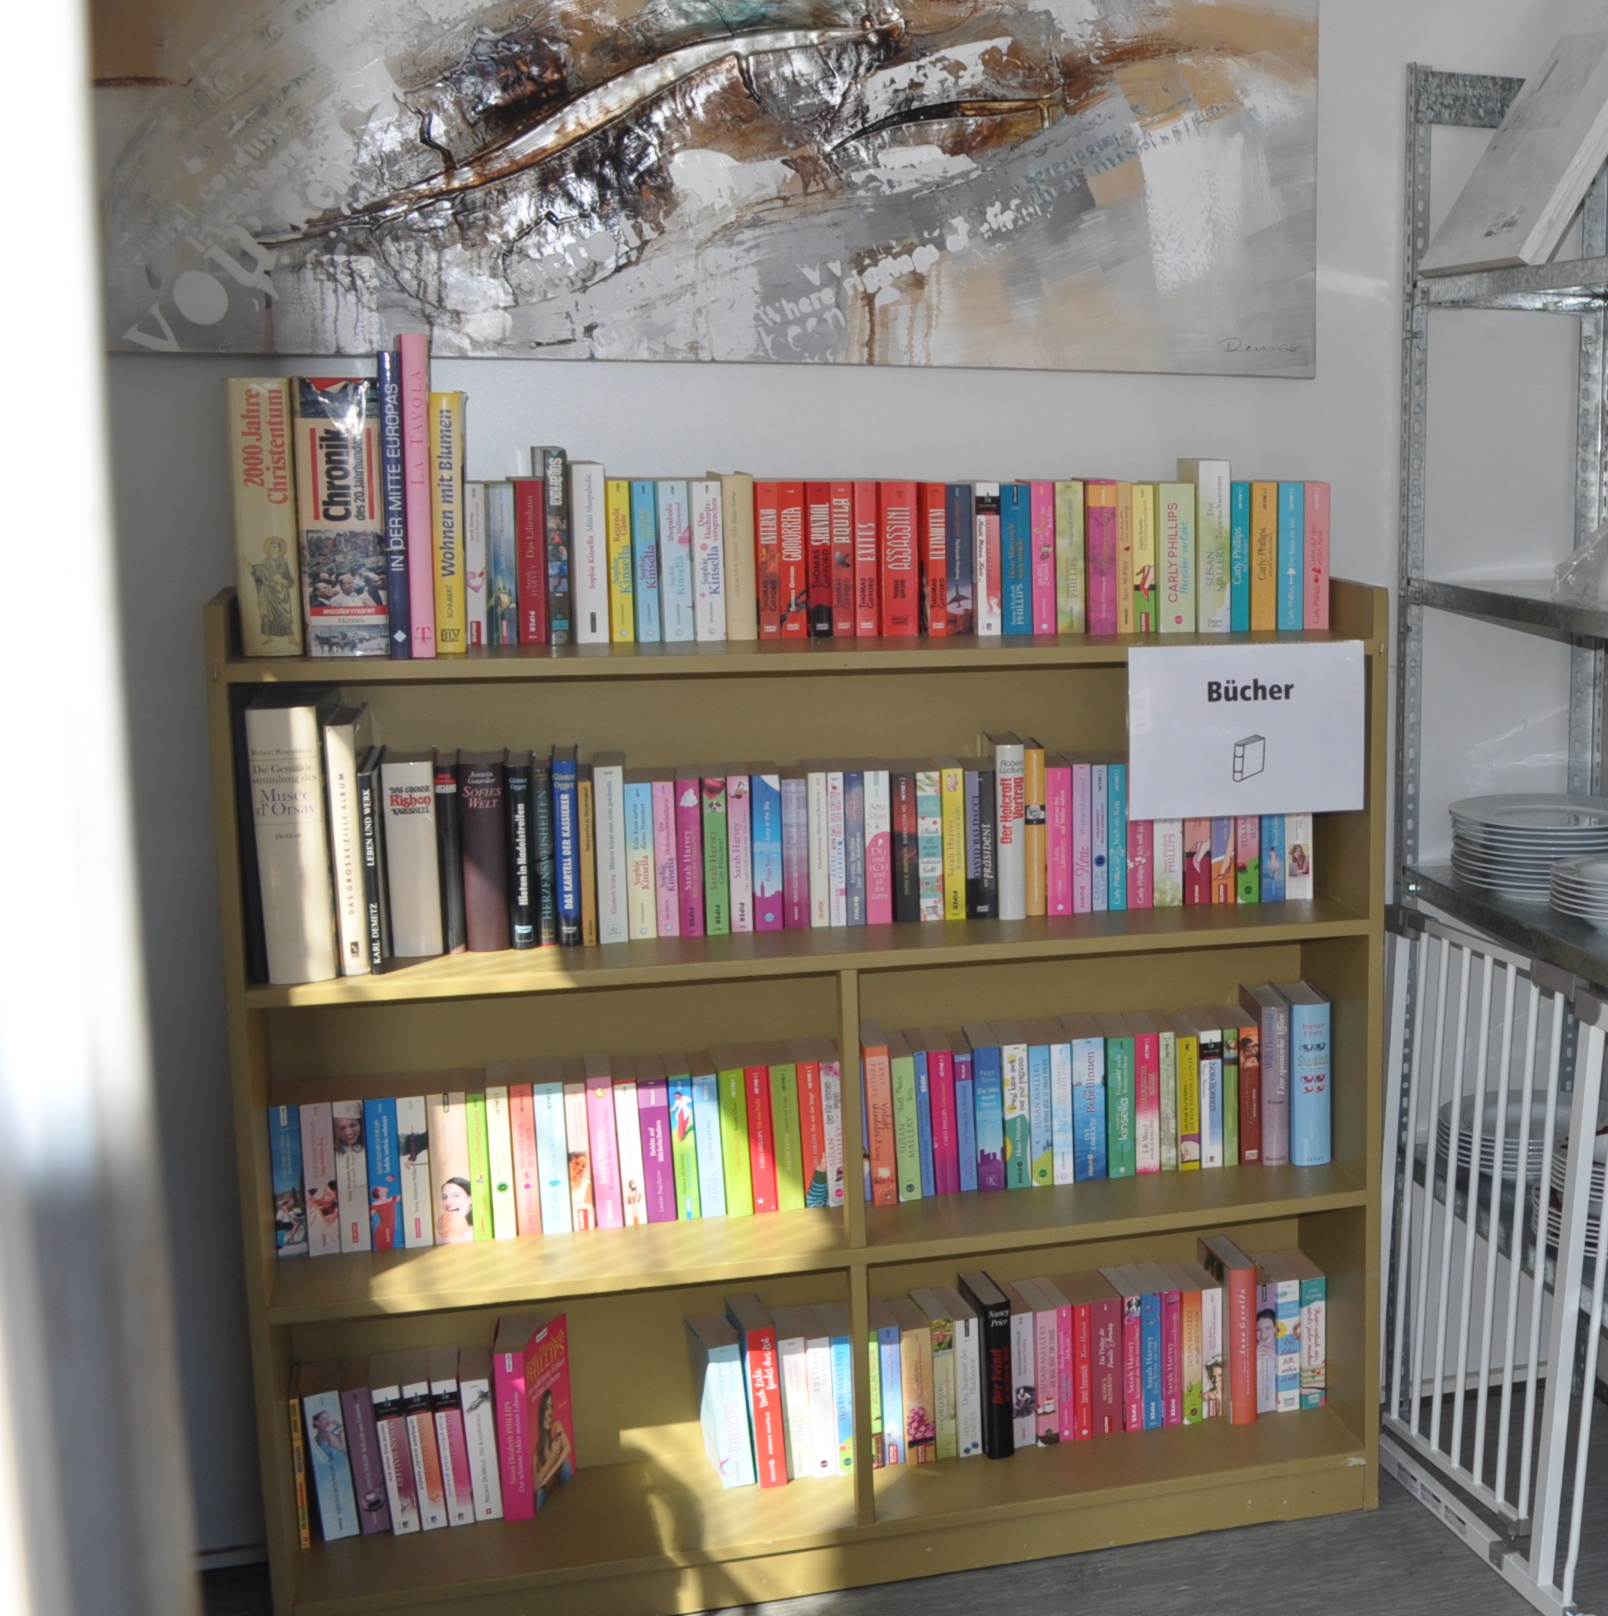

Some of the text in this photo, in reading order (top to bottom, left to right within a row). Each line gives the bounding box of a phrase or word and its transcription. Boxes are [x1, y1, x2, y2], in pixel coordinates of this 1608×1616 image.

[240, 388, 265, 488] 2000 Jahre
[265, 388, 288, 505] Christentum
[409, 371, 425, 485] LA TAVOLA
[319, 429, 352, 522] Chronik
[353, 435, 365, 521] des 20.Jahrhunder
[385, 383, 405, 571] IN DER MITTE EUROPAS
[439, 409, 458, 578] Wohnen mit Blumen
[760, 508, 777, 544] INFERNO
[782, 506, 802, 561] GOMORRHA
[810, 502, 830, 546] SKANDAL
[833, 498, 852, 544] AQUILA
[857, 522, 875, 561] EXITUS
[887, 506, 911, 570] ASSASSINI
[929, 508, 946, 560] ULTIMATUM
[619, 545, 631, 595] Kinsella
[646, 544, 656, 589] Kinsella
[708, 546, 720, 595] Kinsella
[1167, 502, 1178, 603] CARLY PHILLIPS
[1205, 551, 1214, 586] SUSAN
[1216, 545, 1224, 592] MALLERY
[1232, 526, 1242, 585] Carly Phillips
[1257, 528, 1267, 581] Carly Phillips
[1207, 679, 1294, 702] Bücher
[253, 765, 267, 774] Die
[261, 788, 311, 802] Musée
[462, 786, 502, 798] SOFIES
[389, 793, 431, 808] Kishon
[468, 798, 499, 809] WELT
[1000, 778, 1013, 844] Der Holcroft
[1013, 776, 1024, 819] Vertrag
[338, 772, 356, 915] DAS GROSSE ZILLE-ALBUM
[362, 788, 375, 867] LEBEN UND WERK
[514, 802, 529, 907] Nieten in Nadelstreifen
[560, 793, 574, 910] DAS KARTELL DER KASSIERER
[733, 822, 742, 879] Sarah Harvey
[981, 823, 994, 878] PRÄSIDENT
[371, 902, 382, 964] KARL DEMETZ
[1276, 1012, 1286, 1095] Eine spanische Affäre
[1304, 1029, 1324, 1037] Keyes
[1087, 1052, 1095, 1113] Rebellinnen
[1118, 1098, 1129, 1140] kinsella
[989, 1309, 1009, 1318] Nancy
[991, 1318, 1008, 1327] Price
[504, 1400, 517, 1485] Susan Elizabeth PHILLIPS
